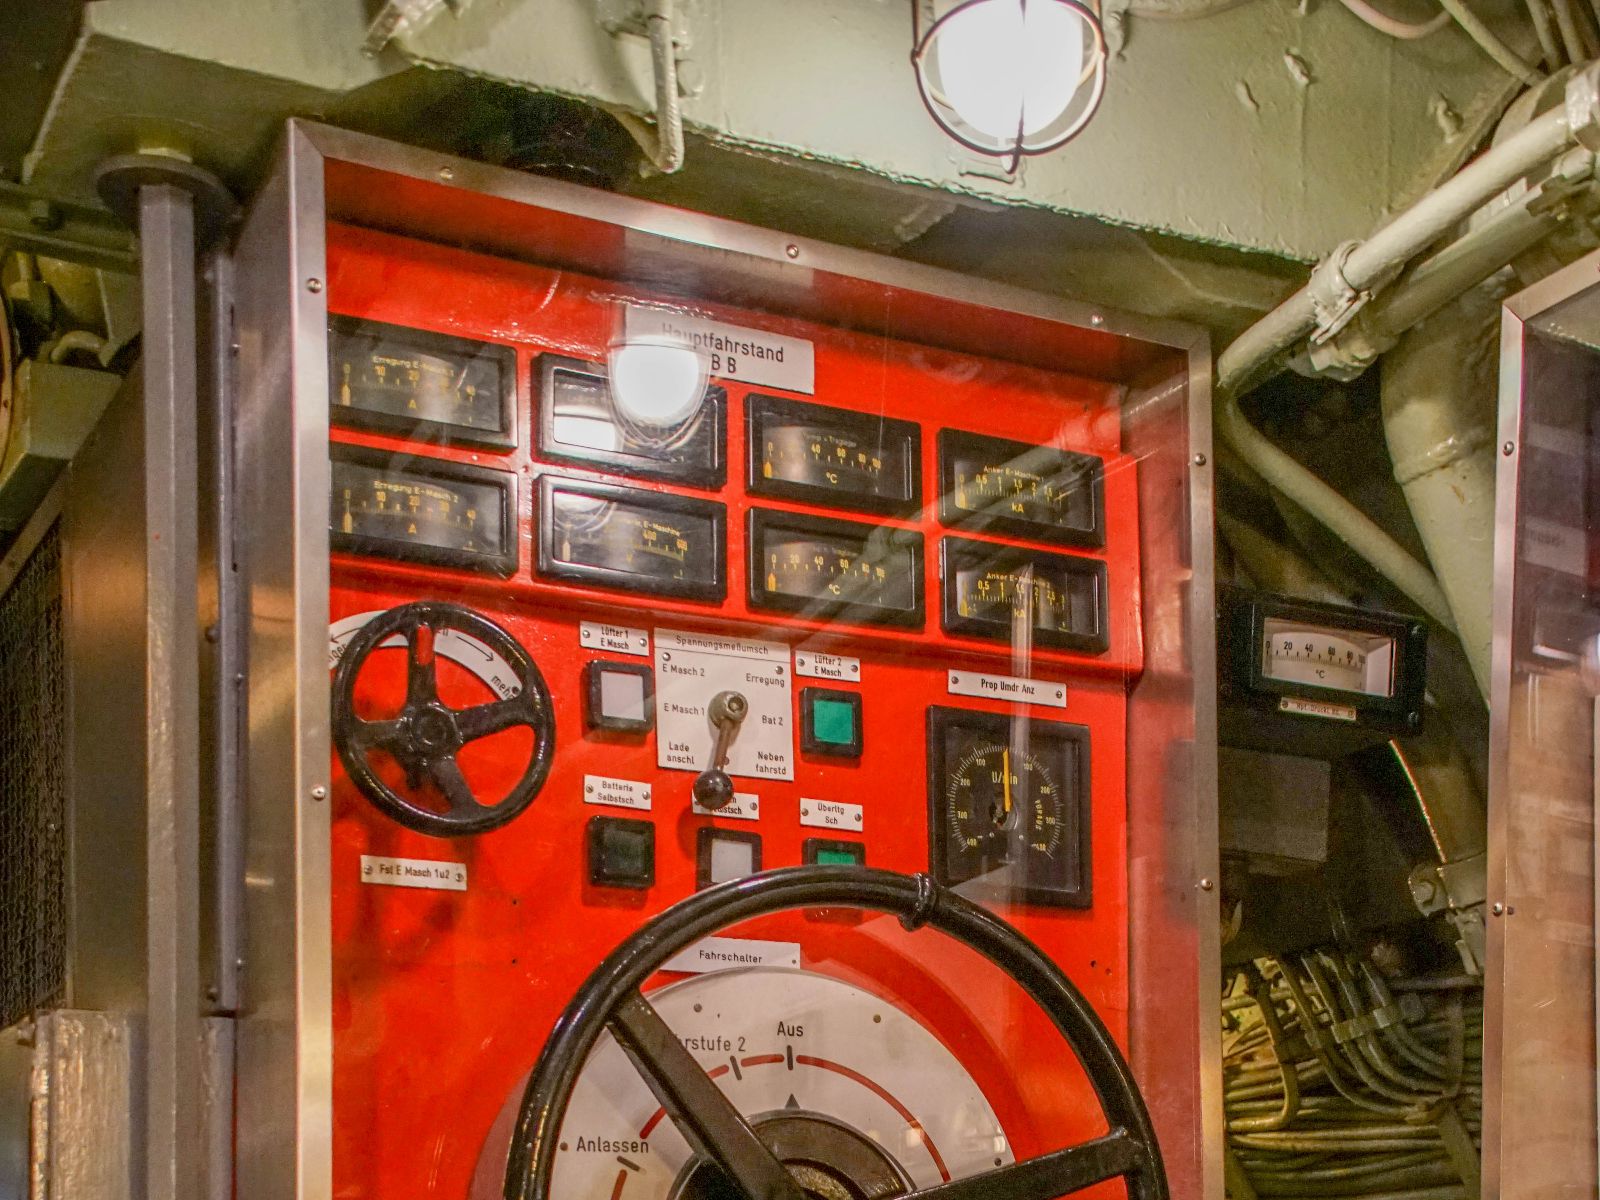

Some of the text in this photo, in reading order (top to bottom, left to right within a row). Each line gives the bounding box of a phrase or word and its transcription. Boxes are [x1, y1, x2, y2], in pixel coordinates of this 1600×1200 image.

[662, 323, 784, 363] Hauptfahrstand
[408, 399, 417, 410] A
[767, 441, 774, 452] 0
[811, 442, 821, 455] 40
[1011, 502, 1024, 514] kA
[771, 553, 777, 564] 0
[789, 552, 801, 565] 20
[814, 555, 824, 566] 40
[977, 579, 990, 591] 0,5
[601, 626, 623, 639] Lüfter
[601, 637, 629, 650] E Masch
[676, 635, 769, 655] Spannungsmeßumsch
[1283, 641, 1293, 651] 20
[1304, 643, 1314, 653] 40
[814, 654, 842, 667] Lüfter 2
[662, 663, 705, 677] E Masch 2
[814, 665, 842, 678] E Masch
[745, 673, 785, 688] Erregung
[980, 678, 1035, 696] Prop Umdr Anz
[663, 702, 669, 712] E
[671, 703, 697, 715] Masch
[761, 714, 783, 726] Bat 2
[669, 741, 690, 753] Lade
[666, 752, 695, 765] anschl
[757, 751, 784, 762] Neben
[756, 762, 787, 776] fahrstd
[991, 770, 1018, 785] U/in
[602, 780, 633, 792] Batterie
[597, 793, 635, 805] Selbstsch
[825, 815, 838, 826] Sch
[379, 863, 450, 880] Fst E Masch 1u2
[699, 949, 763, 964] Fahrschalter
[777, 1021, 804, 1038] Aus
[738, 1036, 747, 1052] 2
[576, 1136, 649, 1154] Anlassen
